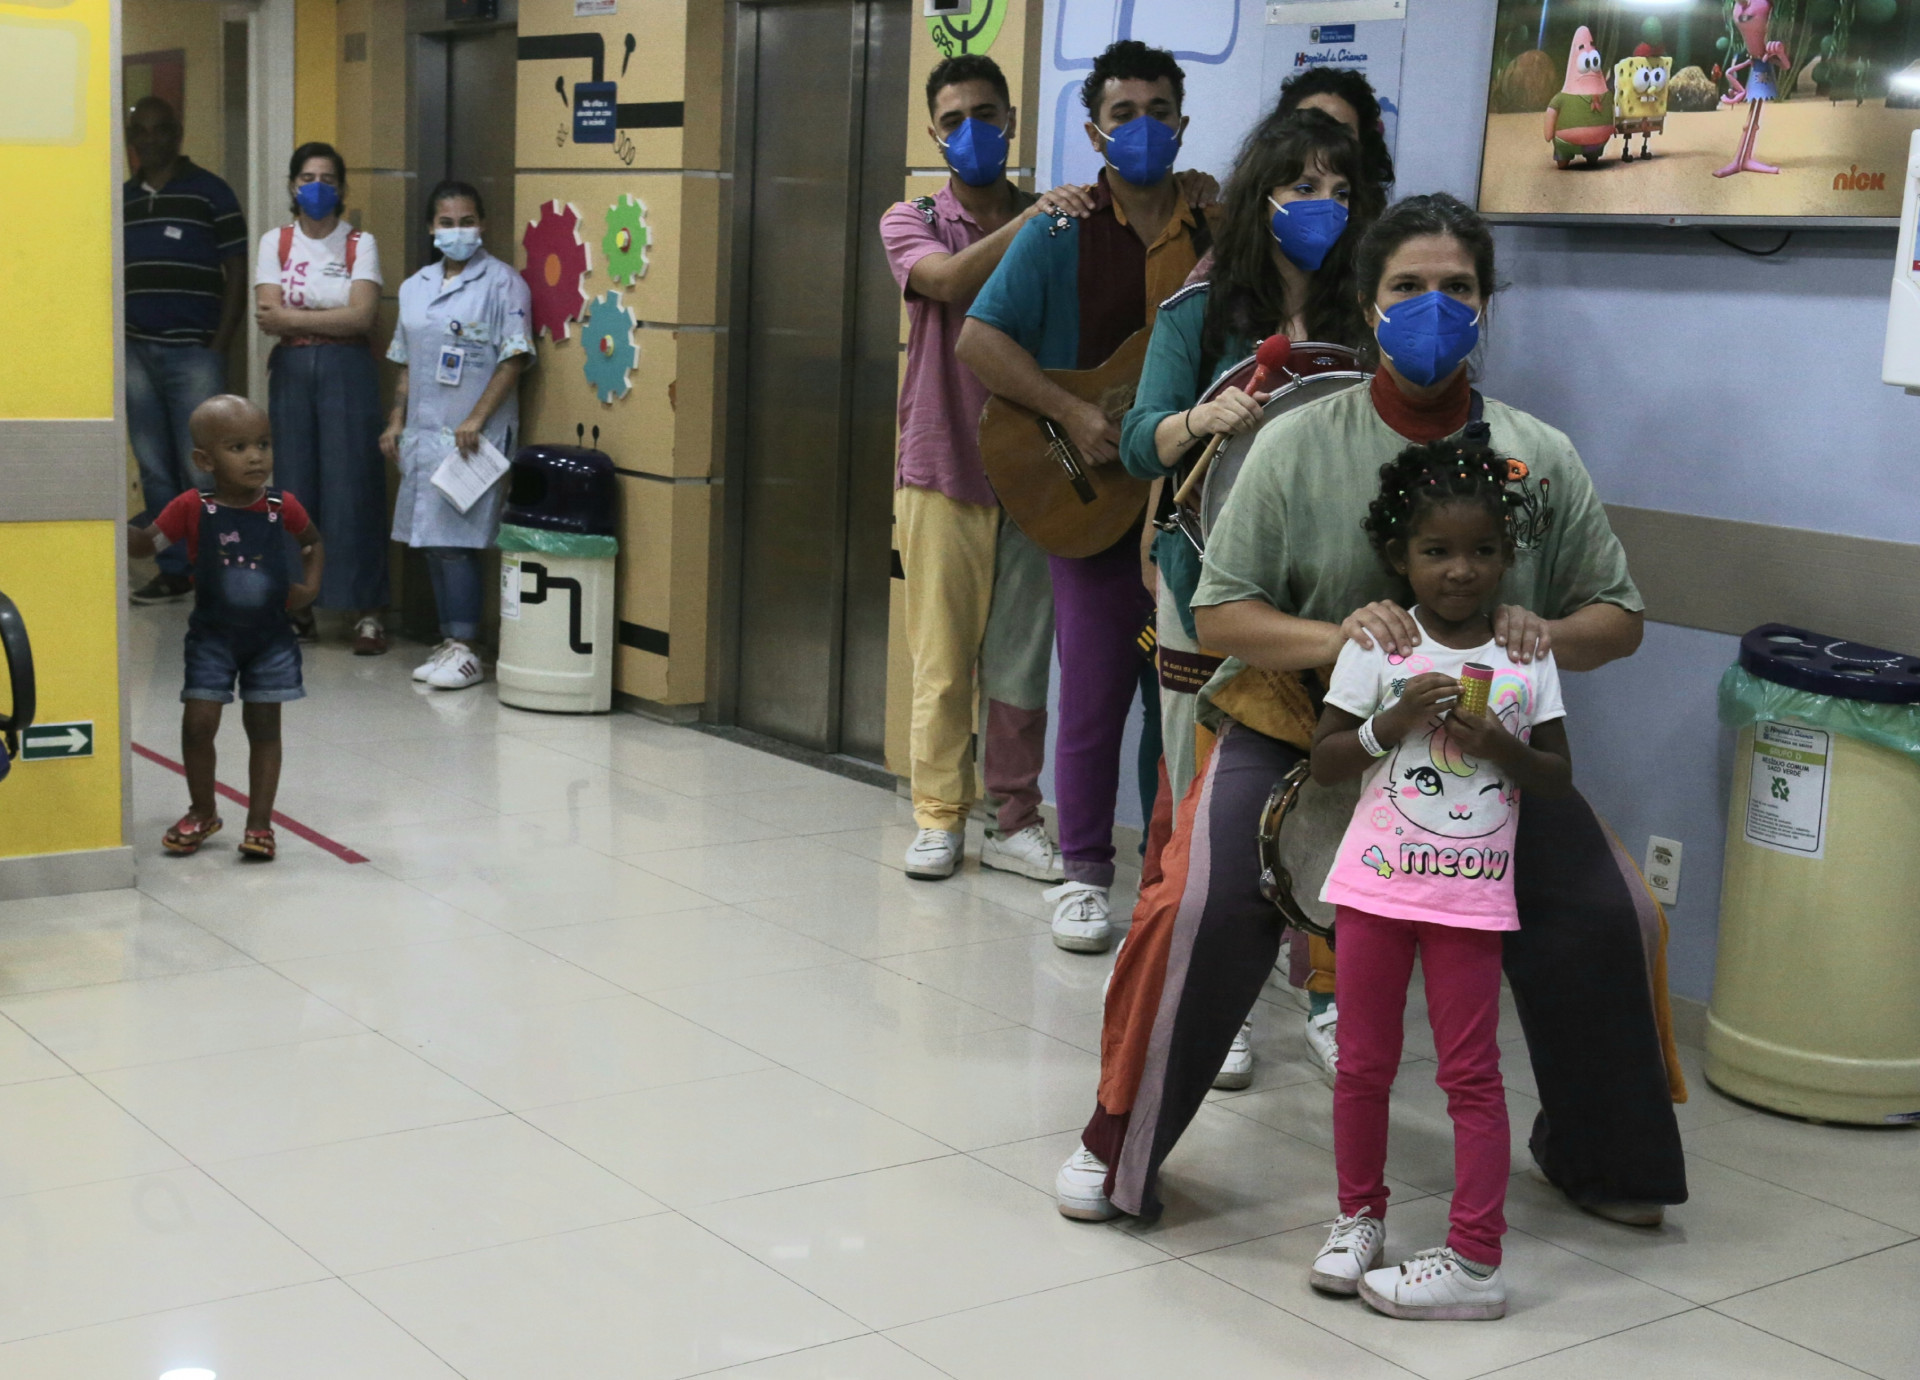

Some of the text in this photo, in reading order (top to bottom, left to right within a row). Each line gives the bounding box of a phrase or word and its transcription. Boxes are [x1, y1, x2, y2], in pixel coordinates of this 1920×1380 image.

[932, 25, 954, 59] GPS
[1294, 49, 1331, 66] Hospital
[1833, 164, 1886, 191] nick
[1767, 765, 1801, 778] SACO VERDE
[1786, 762, 1809, 772] COMUM
[1400, 843, 1509, 881] meow
